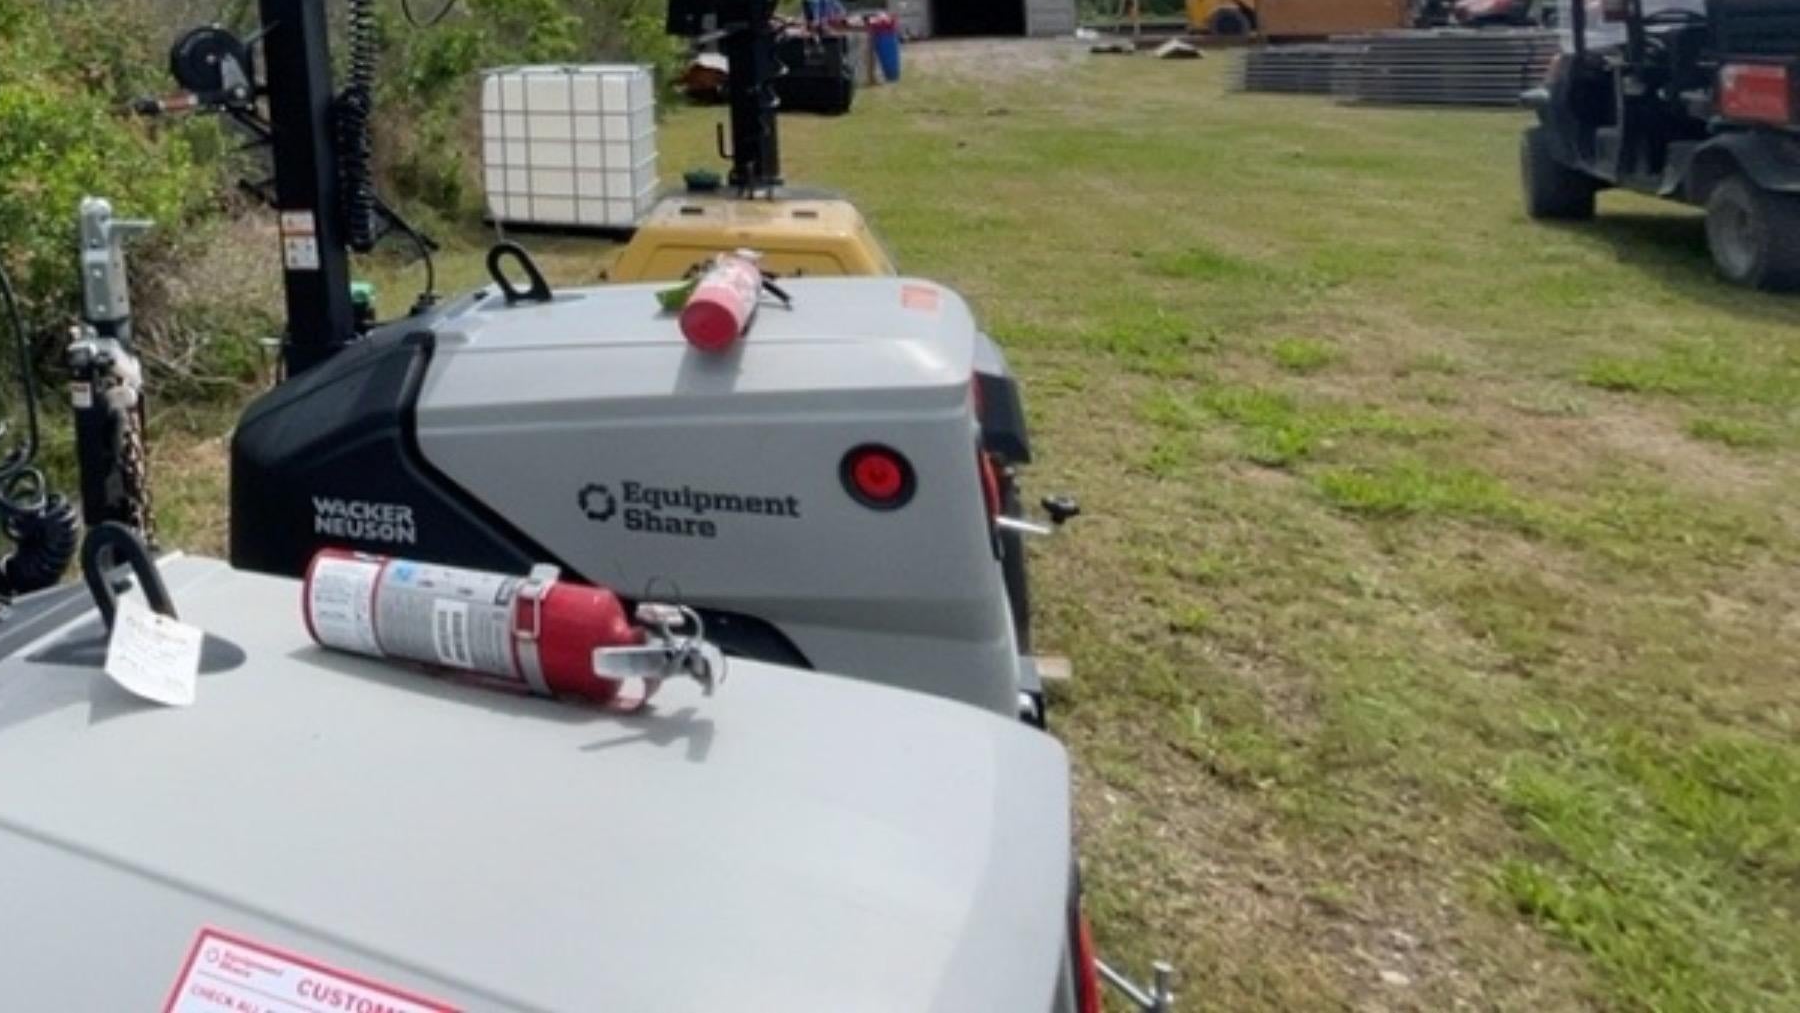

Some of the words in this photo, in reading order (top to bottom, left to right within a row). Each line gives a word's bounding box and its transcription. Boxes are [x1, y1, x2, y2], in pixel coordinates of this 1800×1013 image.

[311, 495, 414, 525] WACKER
[621, 480, 801, 518] Equipment
[314, 514, 416, 544] NEUSON
[623, 507, 717, 538] Share
[296, 978, 408, 1013] CUSTOM
